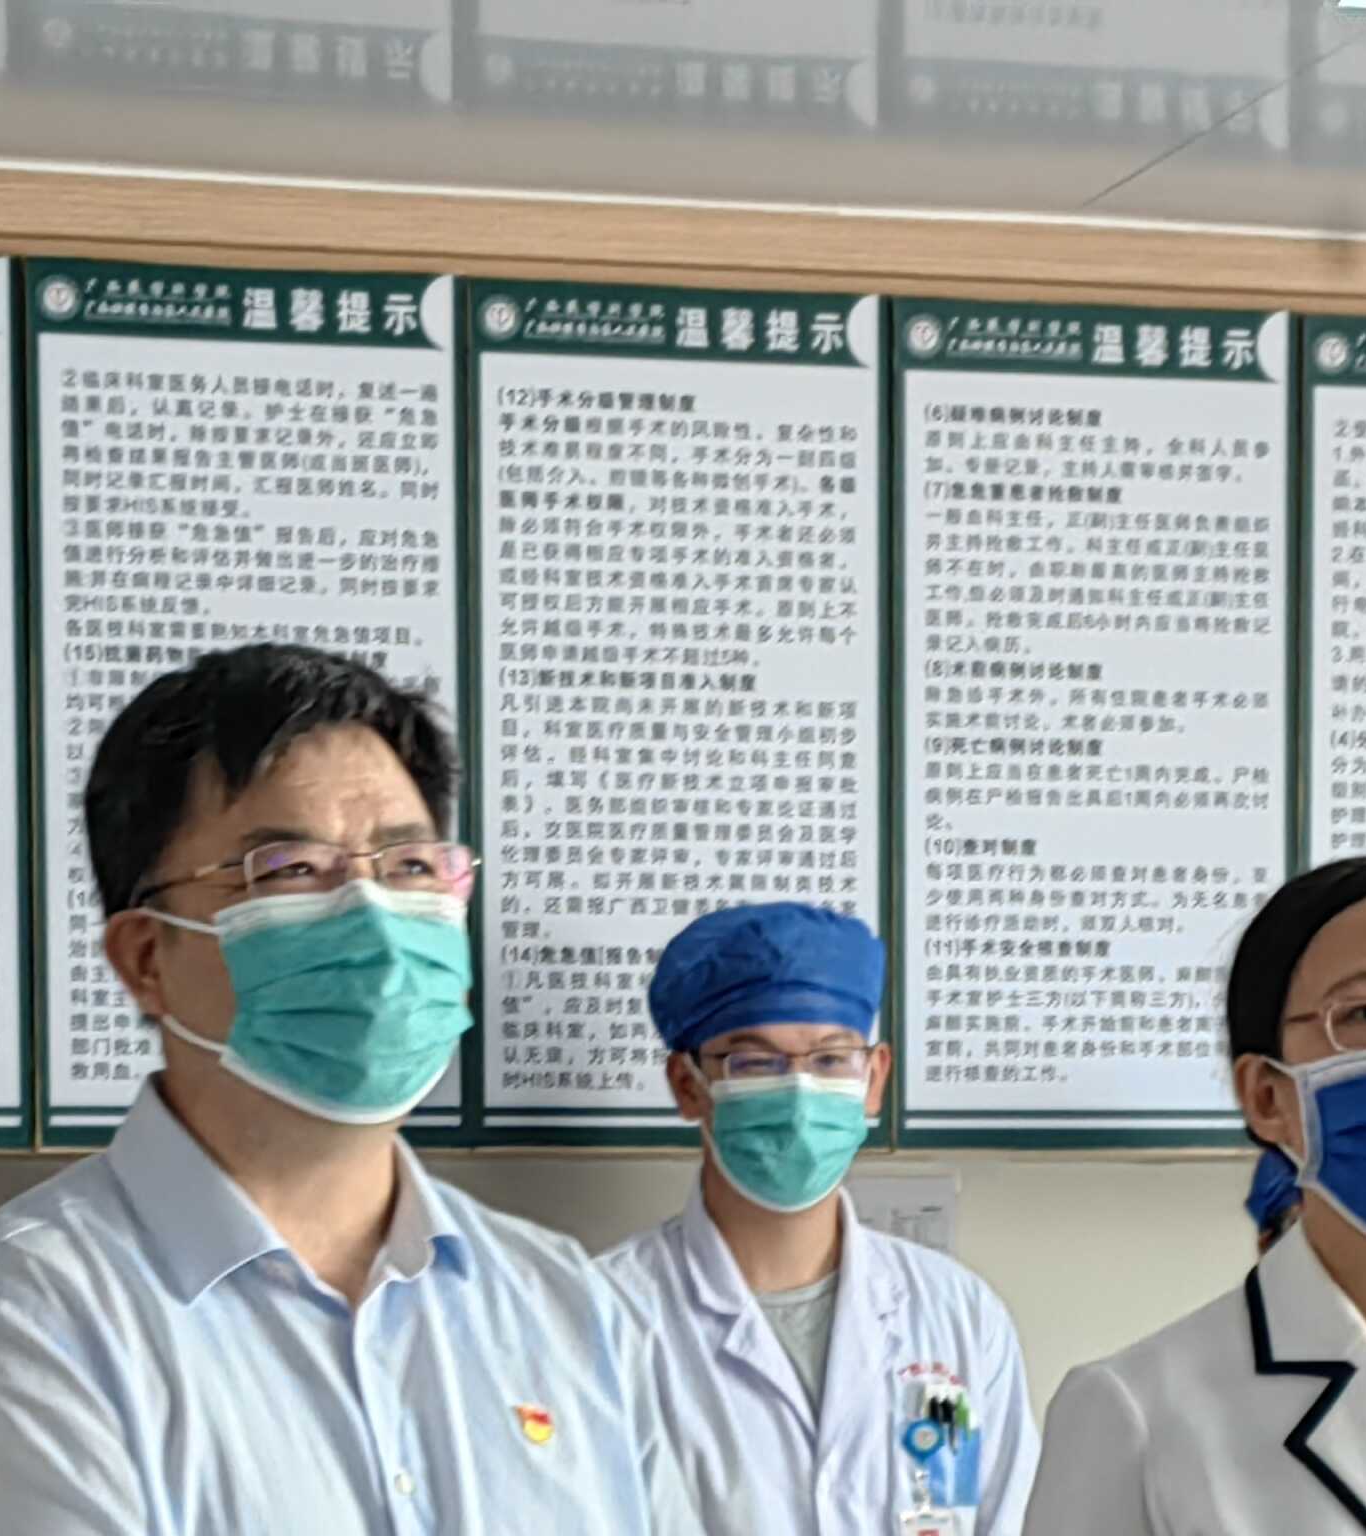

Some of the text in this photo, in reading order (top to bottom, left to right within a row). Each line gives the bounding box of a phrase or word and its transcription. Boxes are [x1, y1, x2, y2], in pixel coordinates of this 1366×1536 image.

[242, 287, 418, 336] 温馨提示
[674, 306, 845, 353] 温馨提示
[1091, 323, 1254, 368] 温馨提示
